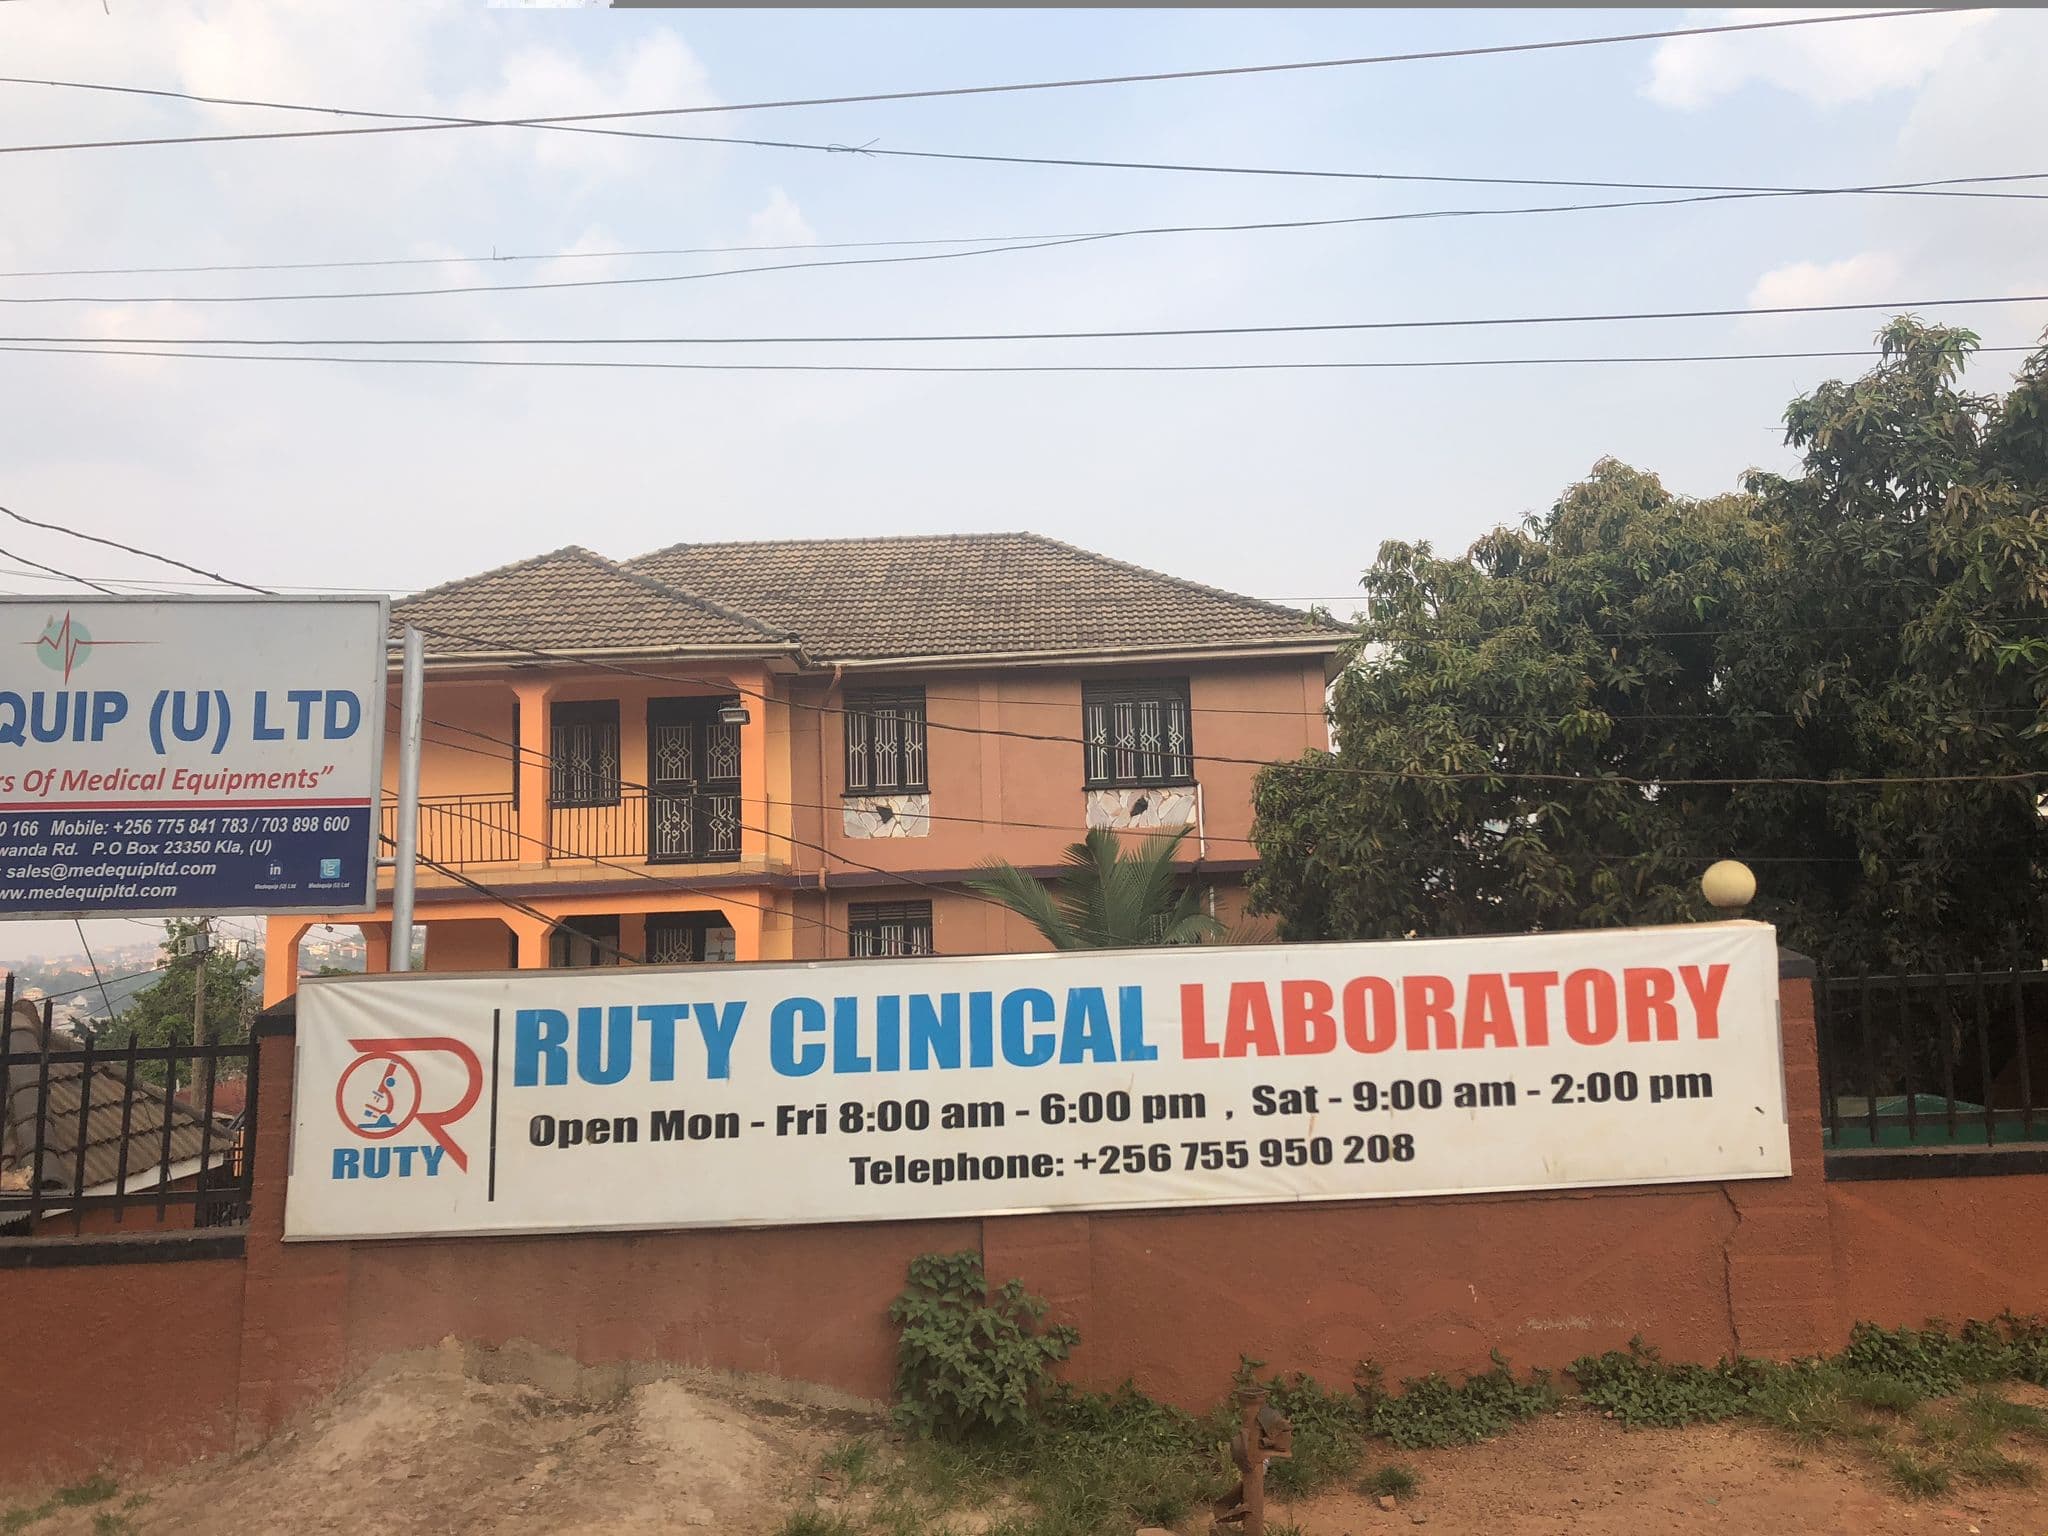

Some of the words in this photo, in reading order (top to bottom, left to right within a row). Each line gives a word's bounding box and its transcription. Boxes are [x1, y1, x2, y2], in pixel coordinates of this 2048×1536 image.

[150, 690, 232, 755] (U)
[253, 689, 361, 741] LTD
[23, 768, 57, 797] Of
[60, 767, 166, 792] Medical
[12, 820, 39, 837] 166
[50, 819, 109, 836] Mobile:
[113, 819, 152, 835] +256
[157, 818, 185, 834] 775
[189, 818, 217, 834] 841
[221, 818, 249, 834] 783
[261, 817, 289, 833] 703
[292, 817, 319, 832] 898
[323, 816, 350, 832] 600
[51, 842, 79, 856] Rd.
[91, 841, 122, 856] P.O
[126, 840, 160, 854] Box
[163, 839, 211, 855] 23350
[214, 839, 245, 855] Kla,
[249, 839, 272, 856] (U)
[6, 861, 217, 881] sales@medequipltd.com
[515, 1001, 748, 1086] RUTY
[770, 985, 1159, 1078] CLINICAL
[1180, 963, 1732, 1061] LABORATORY
[529, 1113, 638, 1151] Open
[650, 1110, 740, 1142] Mon
[776, 1103, 827, 1137] Fri
[839, 1100, 930, 1134] 8:00
[941, 1101, 1005, 1130] am
[1040, 1090, 1131, 1125] 6:00
[1142, 1093, 1206, 1124] pm
[1252, 1083, 1320, 1116] Sat
[1353, 1078, 1442, 1112] 9:00
[1454, 1081, 1516, 1108] am
[1551, 1070, 1638, 1104] 2:00
[1649, 1072, 1713, 1103] pm
[332, 1145, 447, 1180] RUTY
[849, 1152, 1065, 1188] Telephone:
[1074, 1143, 1172, 1175] +256
[1180, 1140, 1249, 1171] 755
[1259, 1136, 1333, 1168] 950
[1343, 1133, 1415, 1164] 208
